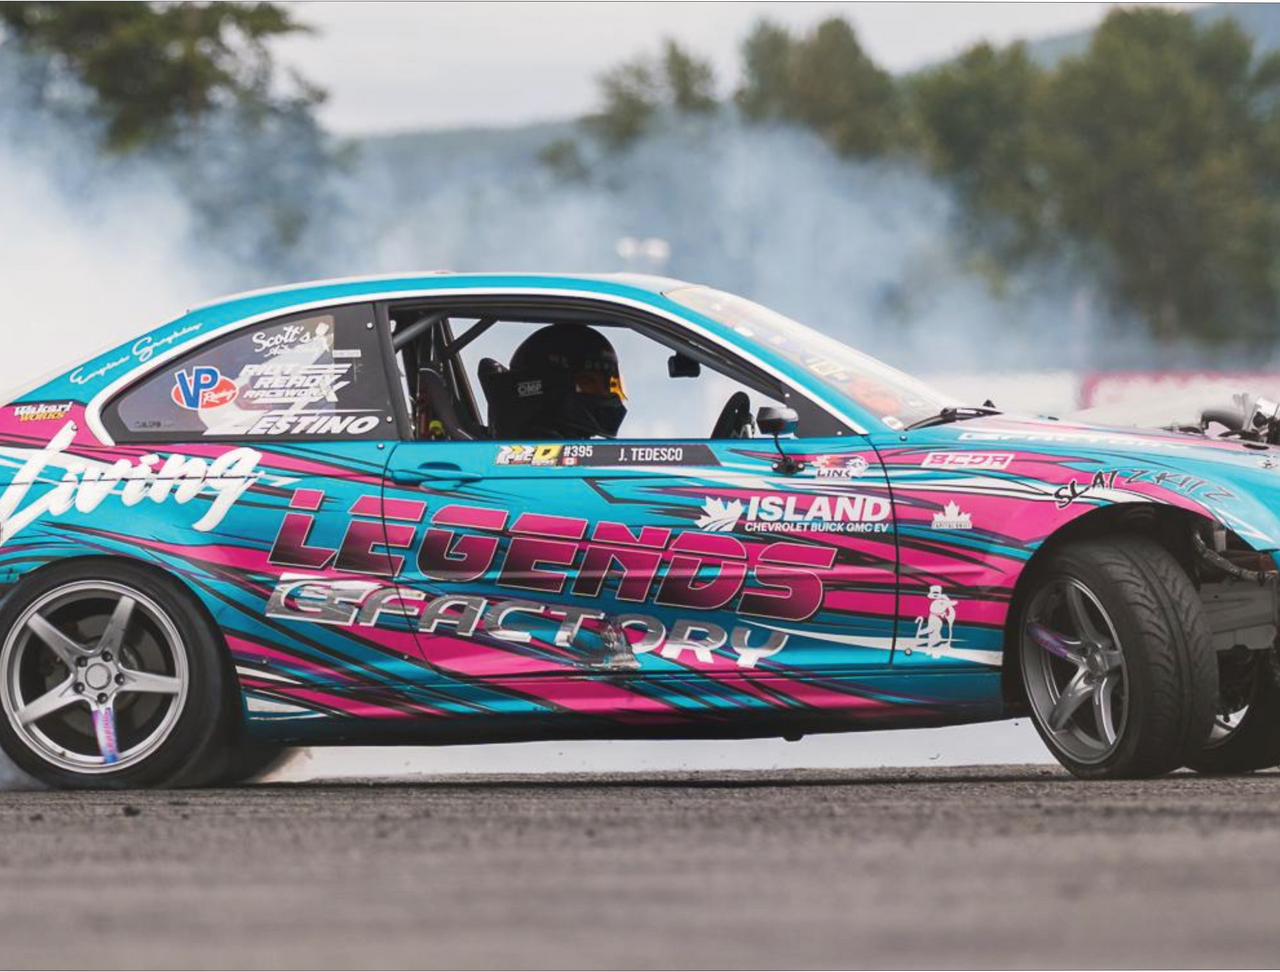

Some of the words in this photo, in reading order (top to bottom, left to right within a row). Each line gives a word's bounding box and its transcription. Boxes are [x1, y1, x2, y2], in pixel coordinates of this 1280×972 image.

[251, 324, 312, 353] Scott's
[174, 366, 220, 411] VP
[563, 446, 593, 457] #395
[631, 448, 683, 462] TEDESCO
[747, 496, 891, 522] ISLAND
[745, 522, 808, 533] CHEVROLET
[810, 522, 845, 532] BUICK
[846, 522, 873, 533] GMC
[874, 523, 889, 532] EV
[266, 487, 838, 621] LEGENDS
